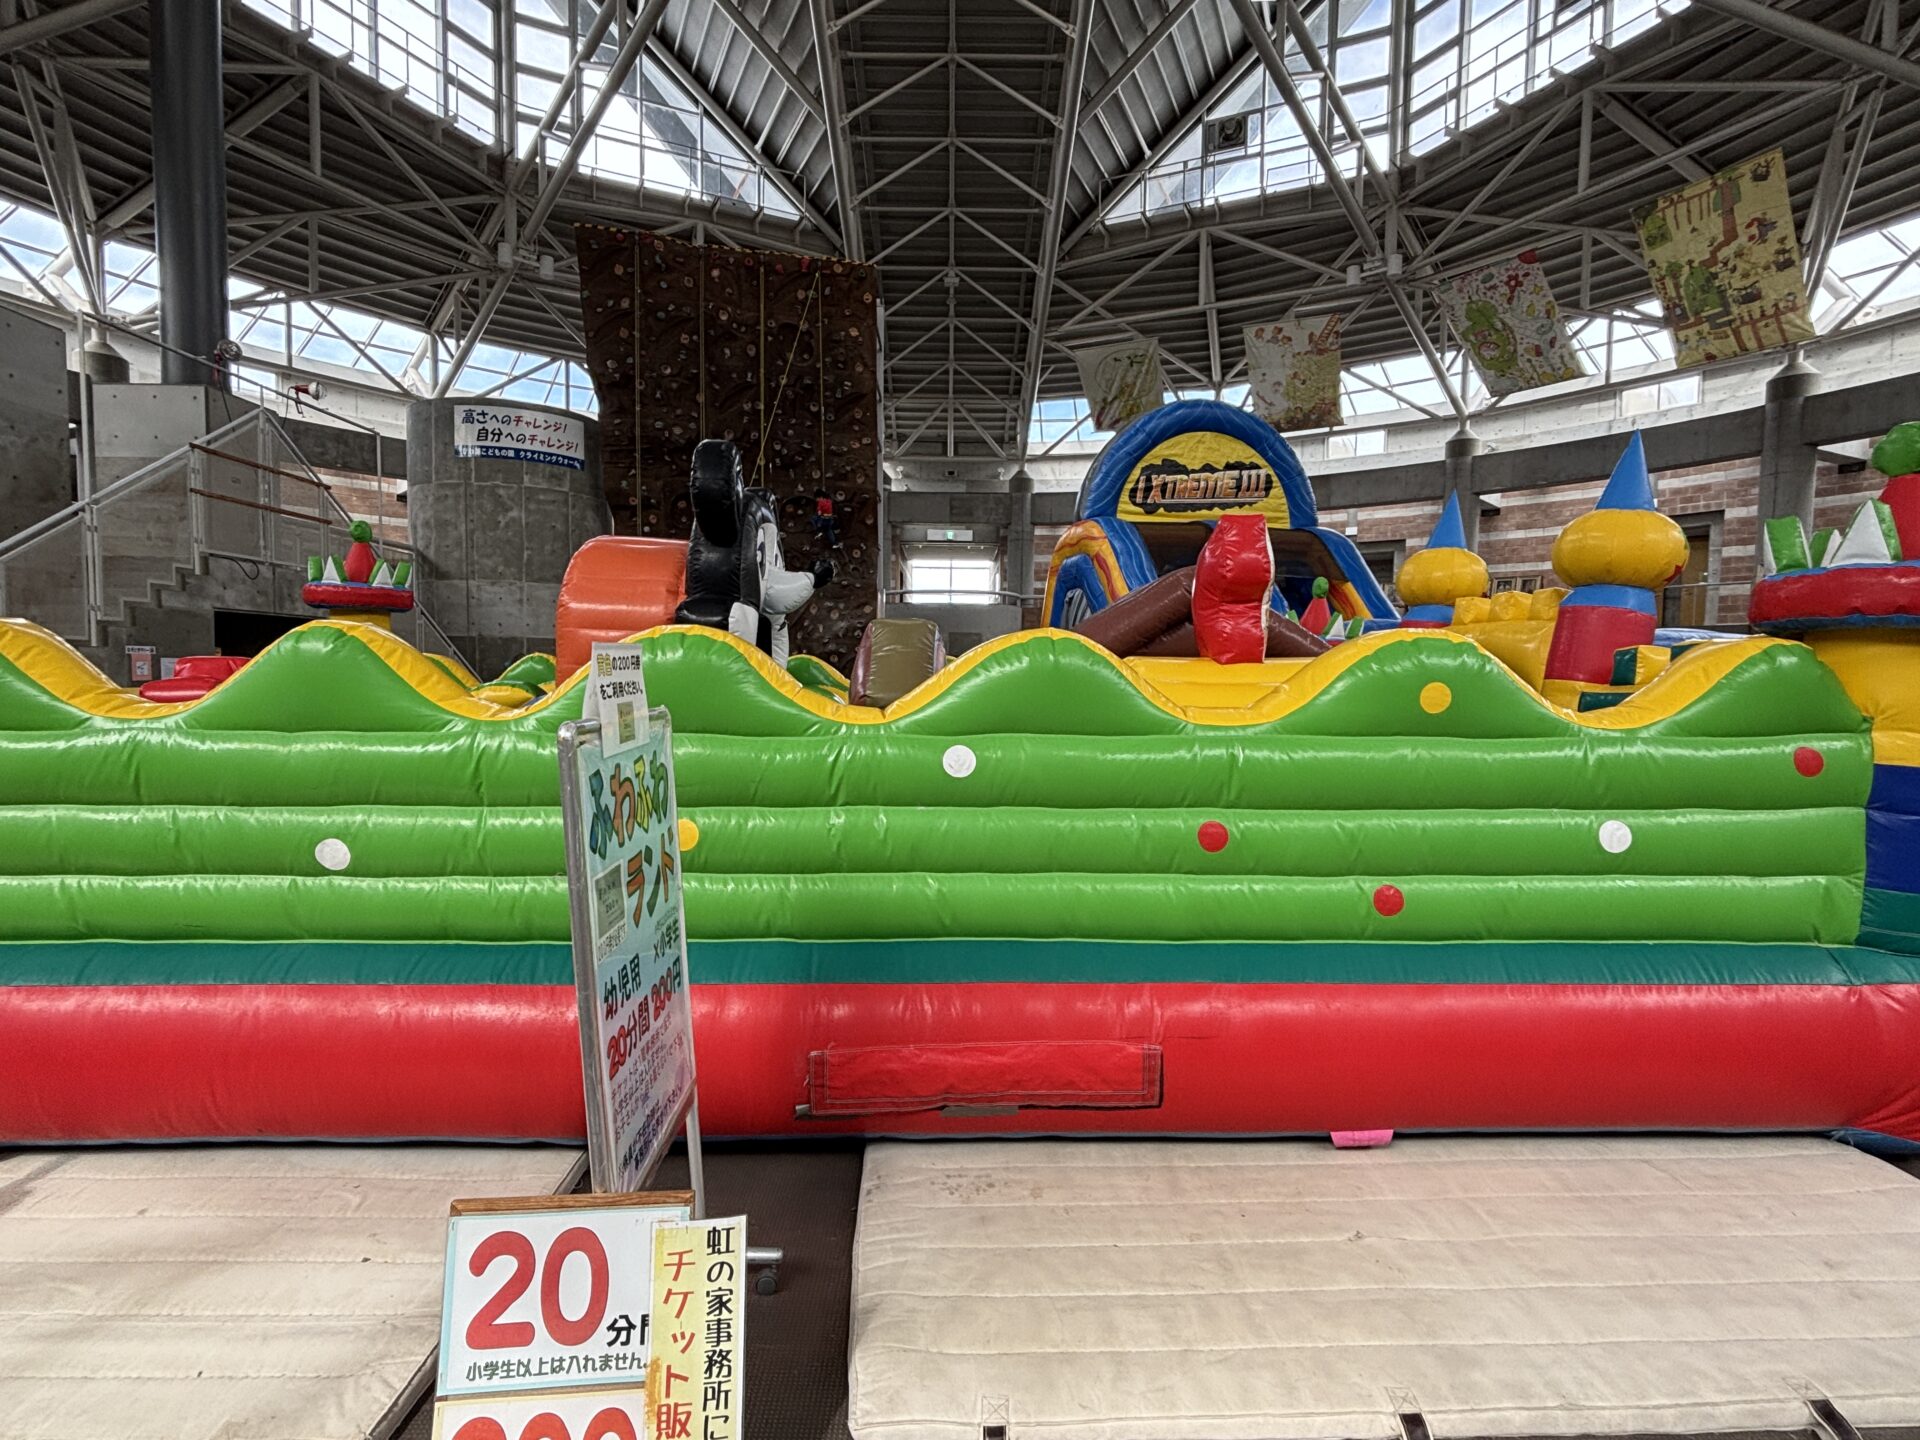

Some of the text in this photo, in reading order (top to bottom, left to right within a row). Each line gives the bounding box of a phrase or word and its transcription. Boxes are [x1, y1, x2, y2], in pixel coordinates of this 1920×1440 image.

[588, 750, 669, 860] ふわふわ
[626, 825, 675, 928] ランド
[603, 953, 641, 1021] 幼児用
[606, 994, 651, 1081] 20分間
[651, 955, 682, 1022] 200円
[655, 1249, 696, 1440] チケット販
[702, 1226, 736, 1440] 虹の家事務所に
